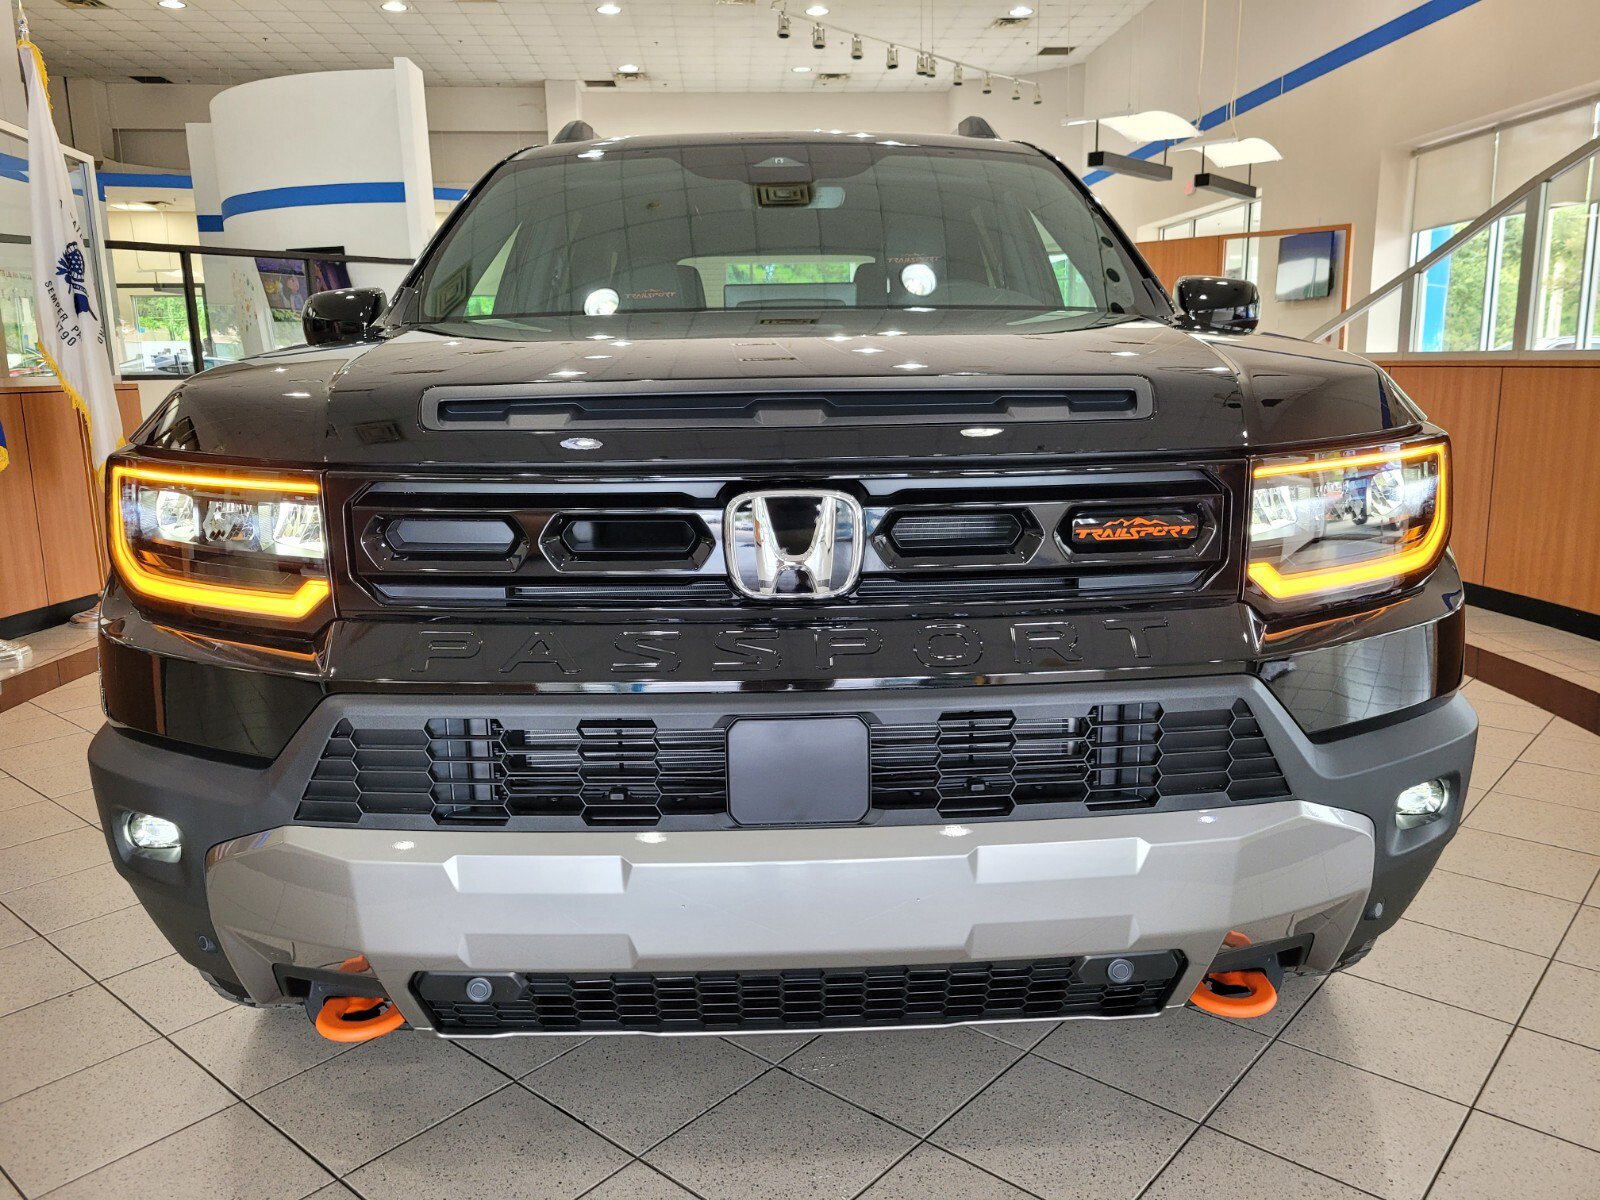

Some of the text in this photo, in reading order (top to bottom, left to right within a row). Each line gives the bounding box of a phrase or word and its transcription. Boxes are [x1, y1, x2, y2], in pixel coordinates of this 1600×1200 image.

[45, 281, 69, 322] SEMPER
[56, 322, 77, 347] 1790
[1075, 525, 1196, 541] TRAILSPORT
[410, 617, 1169, 674] PASSPORT
